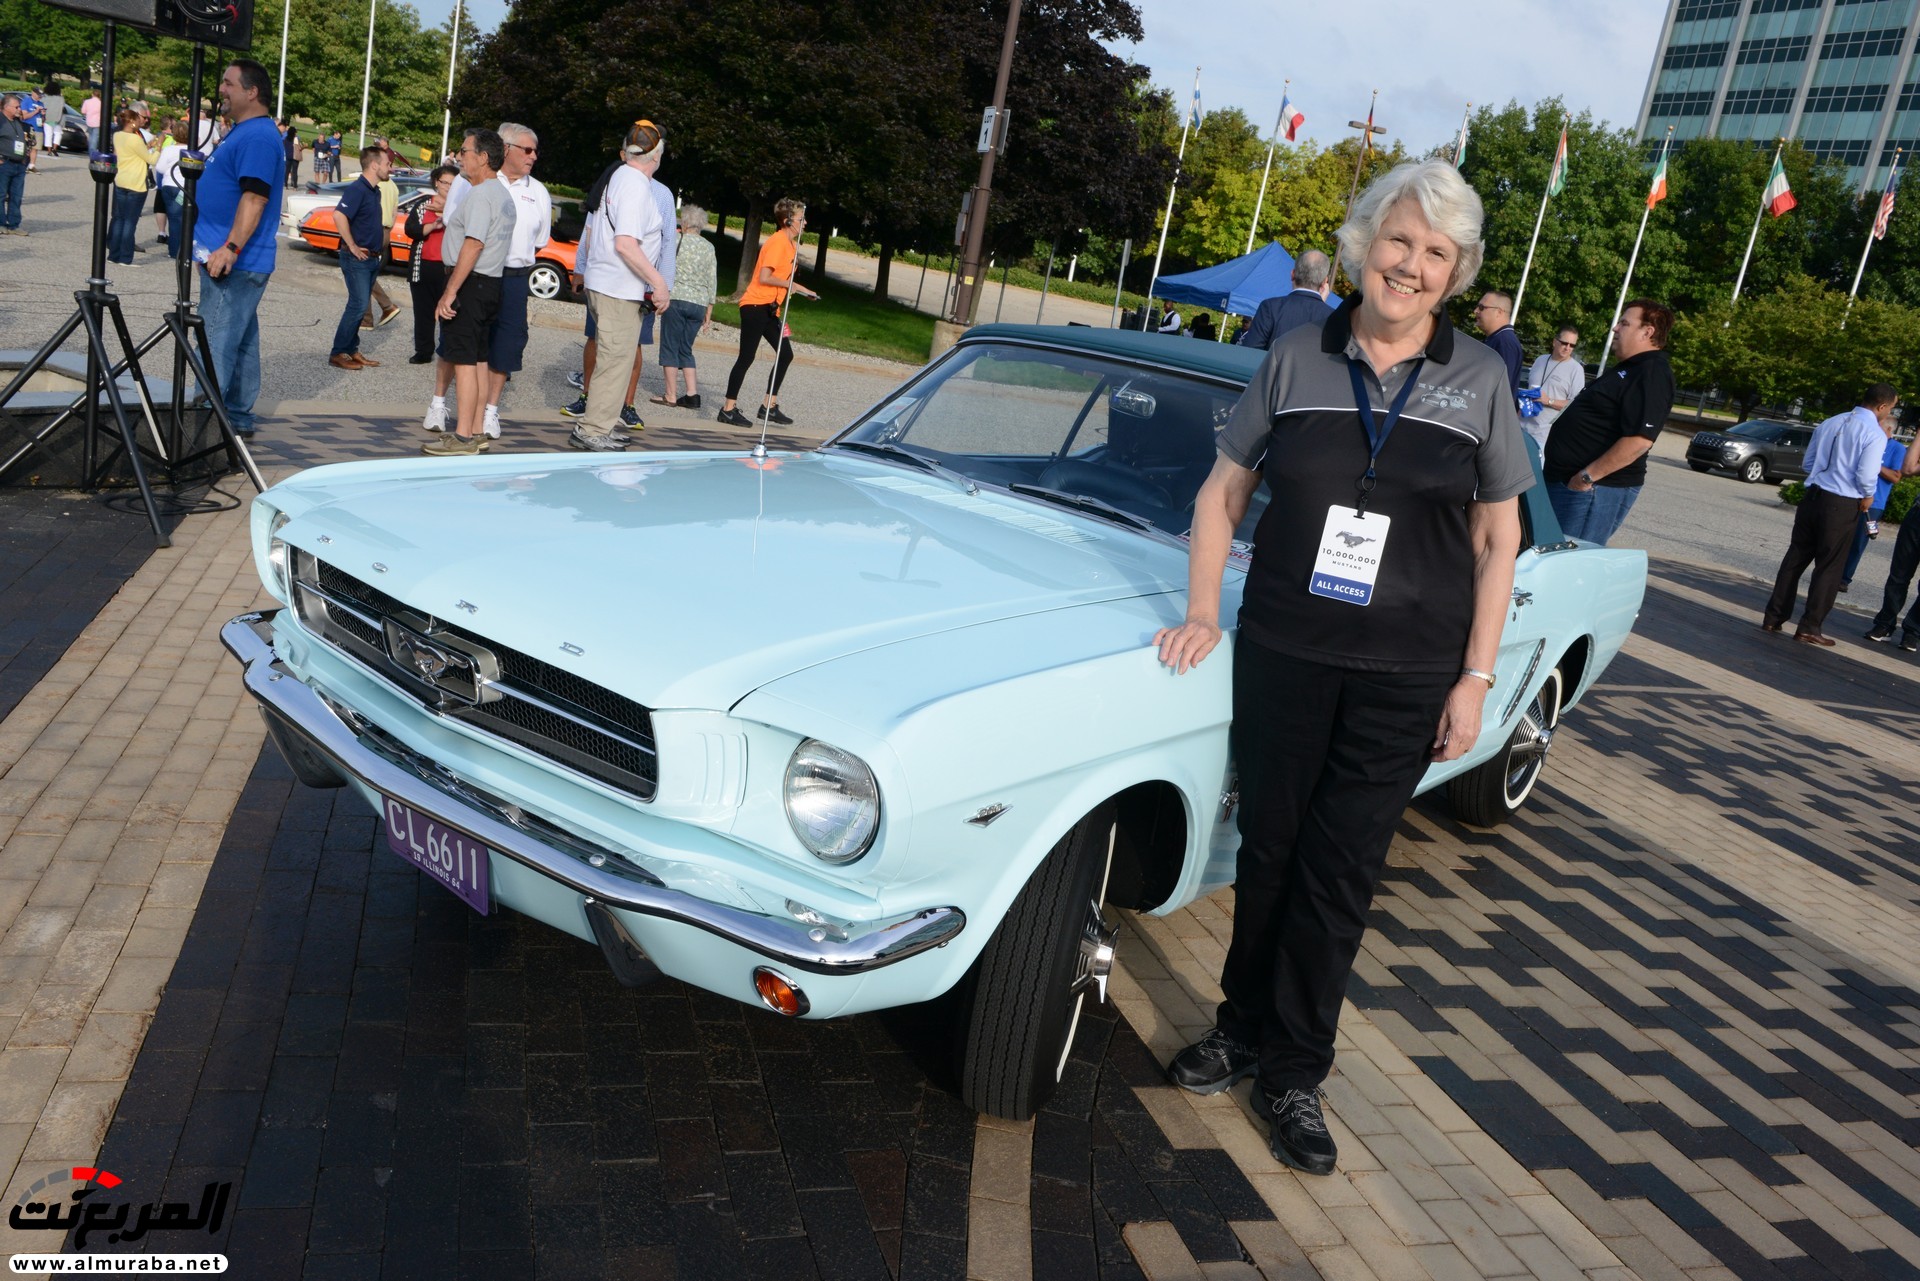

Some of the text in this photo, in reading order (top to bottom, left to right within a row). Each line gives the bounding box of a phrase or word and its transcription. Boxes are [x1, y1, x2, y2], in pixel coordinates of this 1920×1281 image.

[984, 115, 993, 123] LOT
[1418, 382, 1477, 399] MUSTANG
[1322, 548, 1376, 565] 10,000,000
[1332, 560, 1362, 570] MUSTANG
[1316, 580, 1365, 598] ALL ACCESS
[413, 851, 460, 890] 19 ILLINOIS 64
